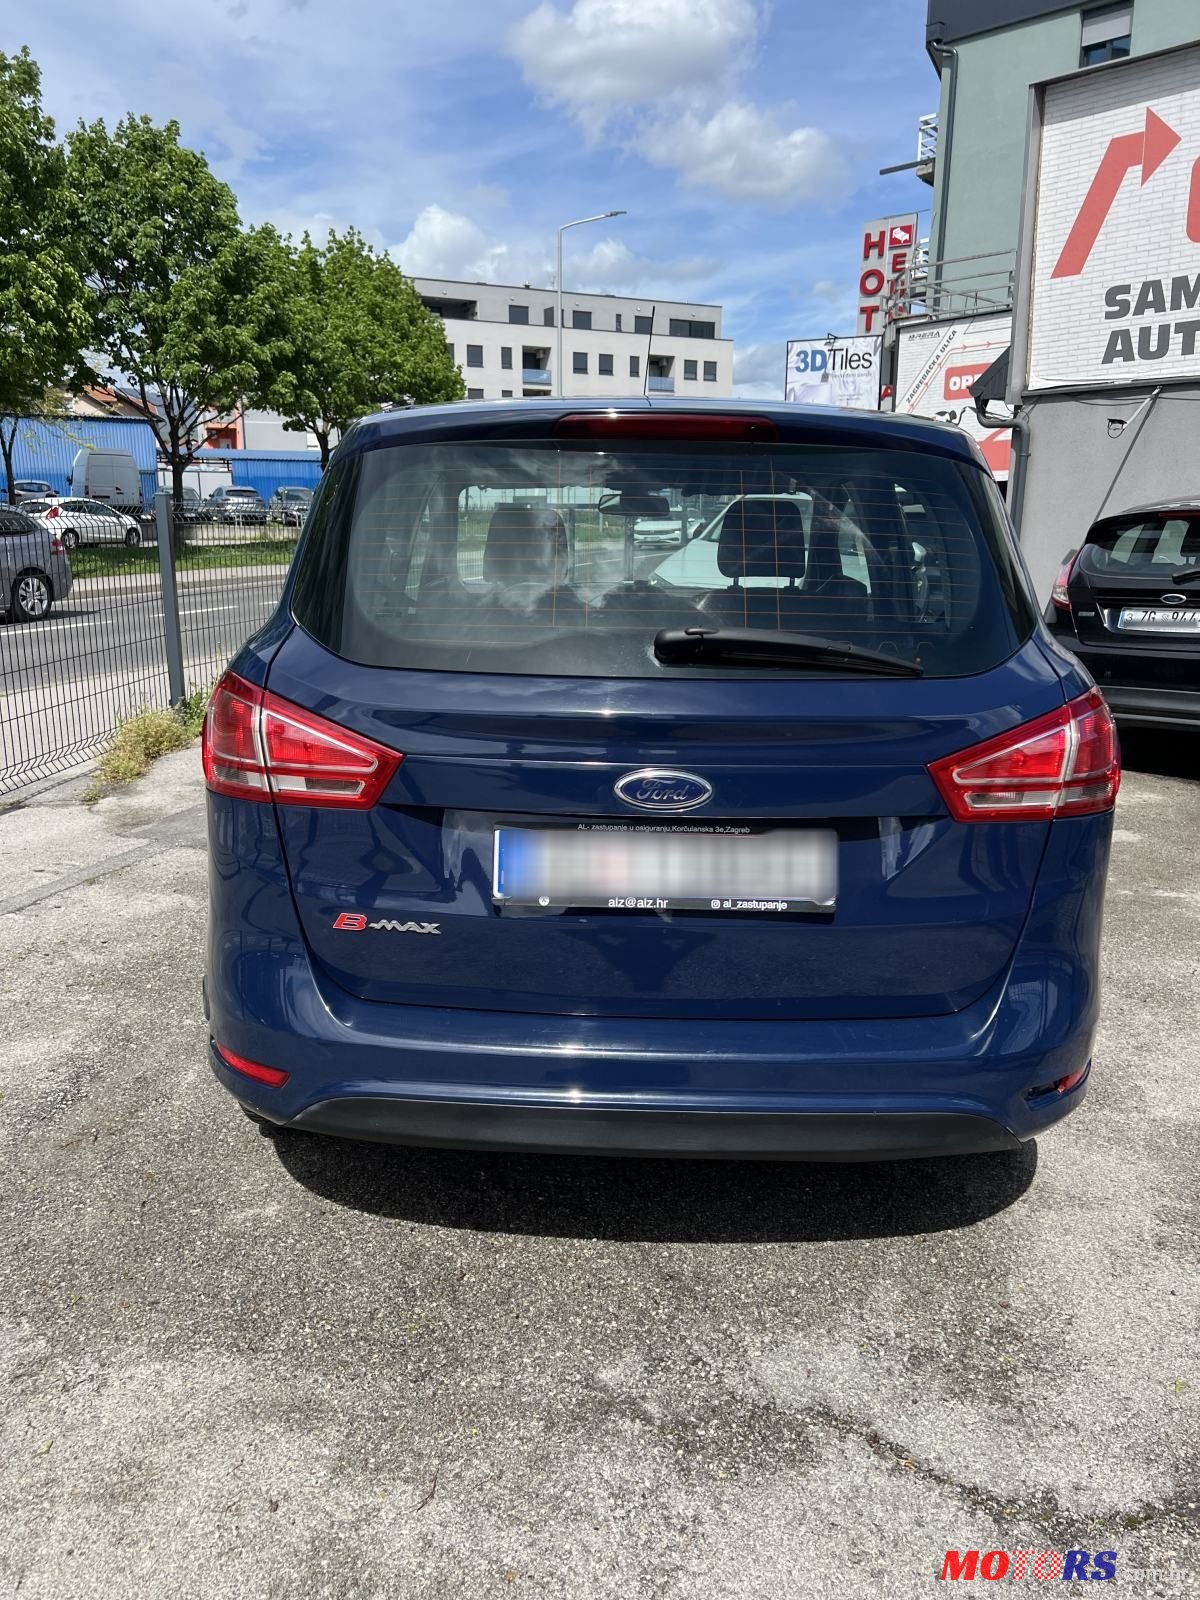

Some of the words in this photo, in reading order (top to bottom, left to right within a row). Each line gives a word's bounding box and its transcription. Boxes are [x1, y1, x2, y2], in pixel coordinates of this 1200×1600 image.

[1104, 273, 1200, 320] SAM
[940, 329, 958, 354] ULICA
[1101, 320, 1200, 365] AUT
[636, 778, 689, 800] Ford
[333, 912, 441, 934] B-MAX
